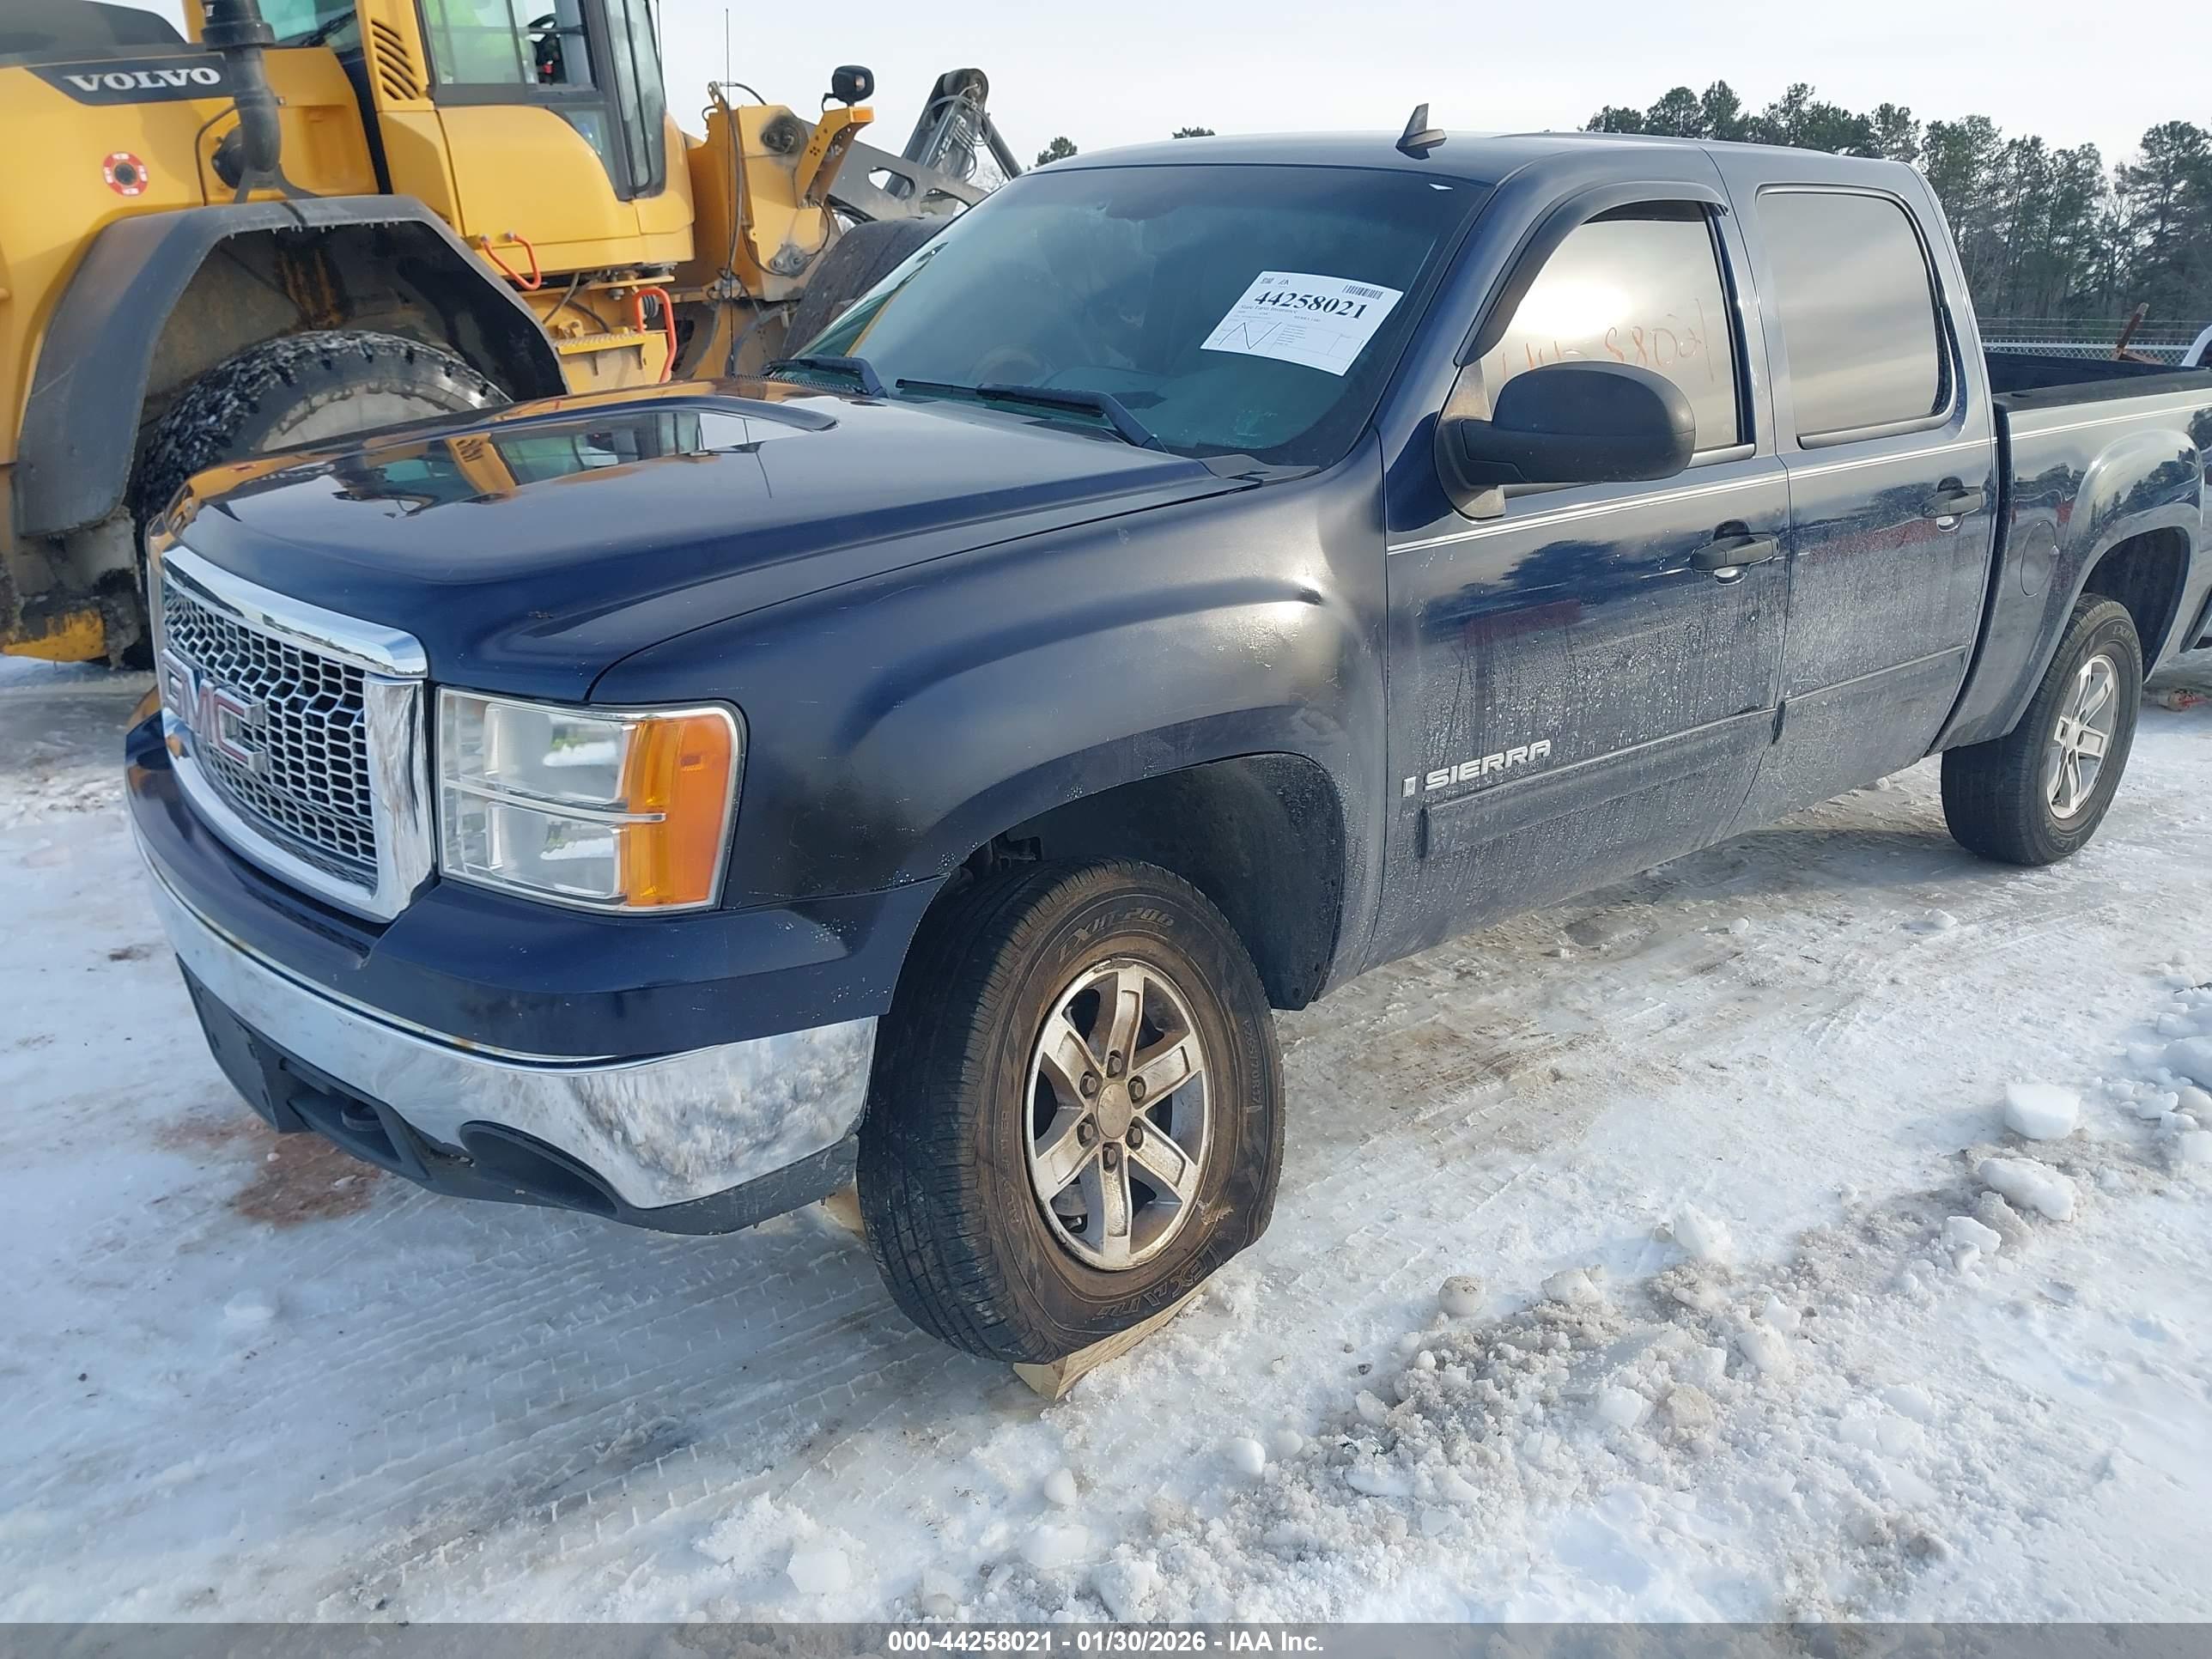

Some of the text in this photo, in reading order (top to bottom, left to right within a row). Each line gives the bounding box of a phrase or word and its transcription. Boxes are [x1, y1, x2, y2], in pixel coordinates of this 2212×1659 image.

[64, 67, 222, 92] VOLVO
[1255, 291, 1367, 320] 44258021
[161, 647, 270, 774] GMC
[1423, 739, 1552, 792] SIERRA
